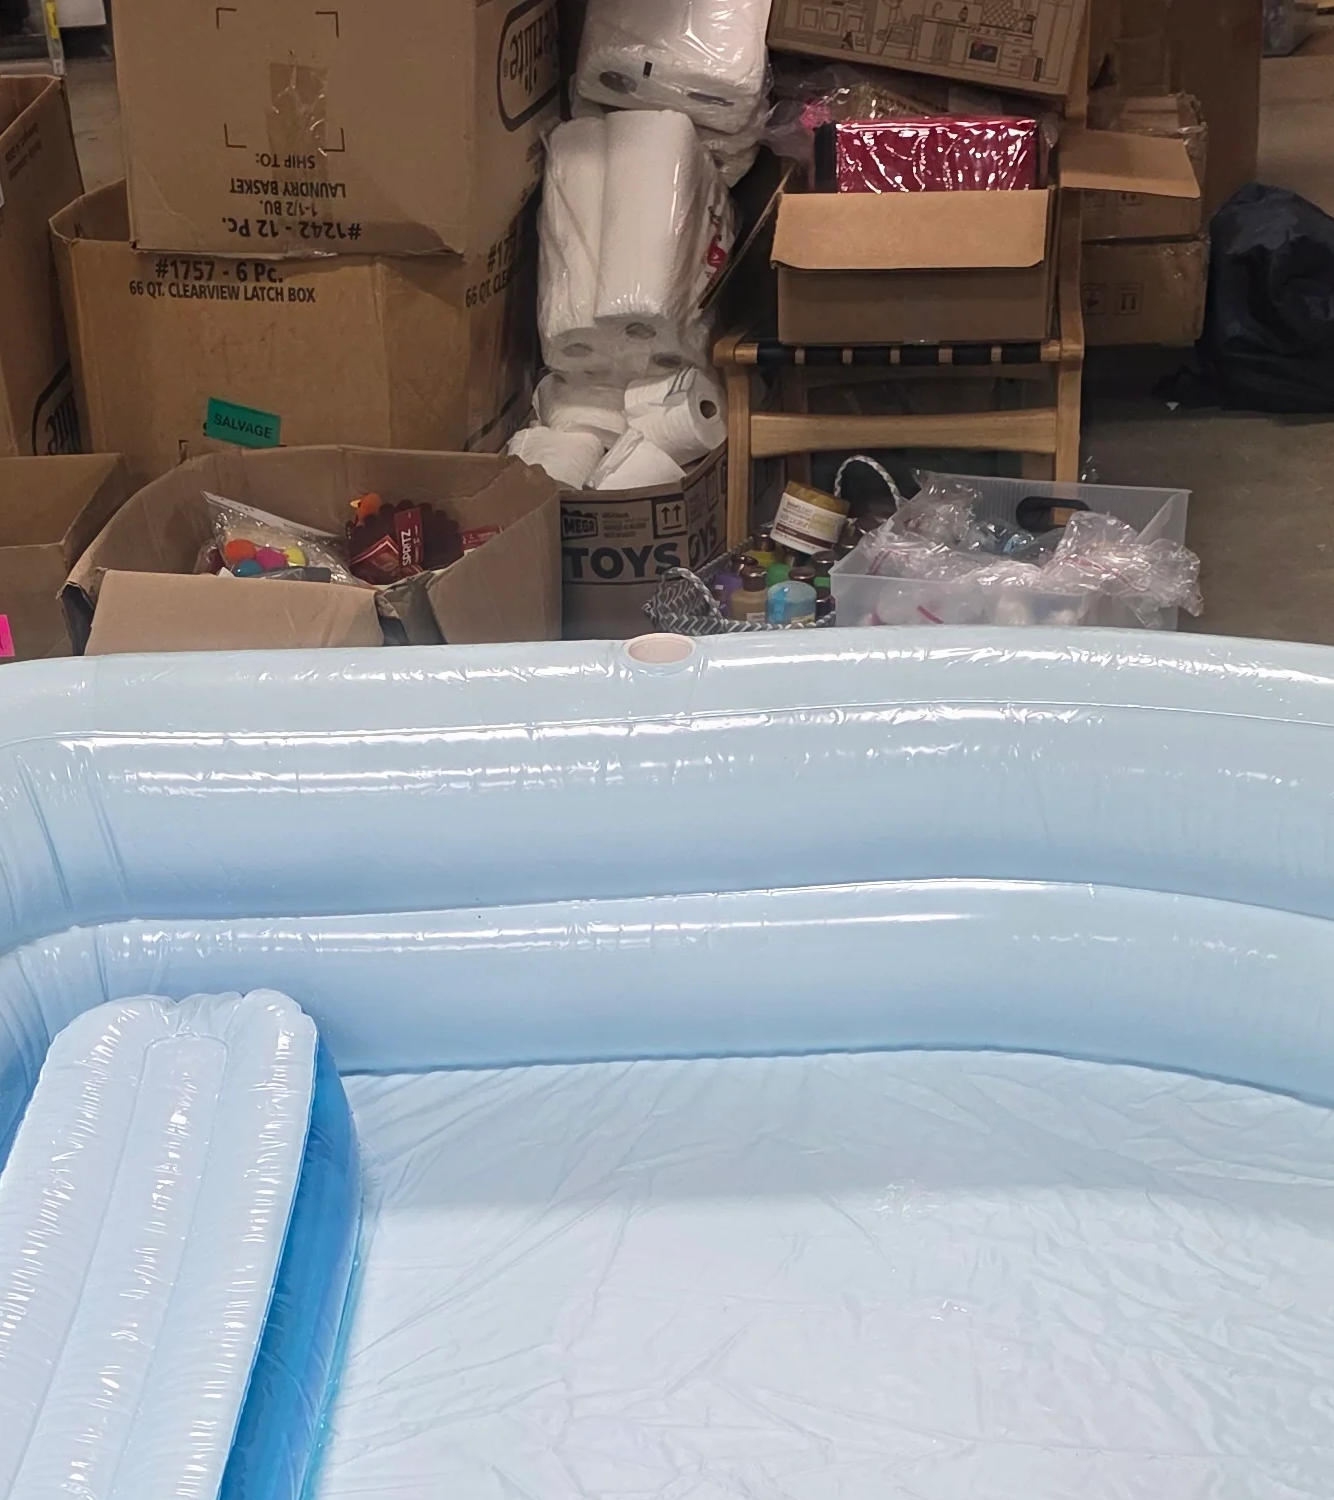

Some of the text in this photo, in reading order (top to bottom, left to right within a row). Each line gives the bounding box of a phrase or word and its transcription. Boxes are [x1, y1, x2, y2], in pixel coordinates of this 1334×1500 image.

[255, 153, 316, 169] SHIP TO:
[229, 178, 347, 198] LAUNDRY BASKET
[259, 200, 318, 217] 1-1/2 BU.
[221, 217, 251, 238] Pc.
[256, 219, 279, 238] 12
[298, 221, 363, 241] #1242
[155, 258, 216, 281] #1757
[236, 262, 248, 283] 6
[254, 262, 284, 283] Pc.
[129, 280, 316, 303] 66 QT. CLEARVIEW LATCH BOX
[213, 412, 273, 439] SALVAGE
[563, 517, 596, 534] MEGA
[400, 528, 411, 565] SPRITZ
[562, 542, 682, 579] TOYS
